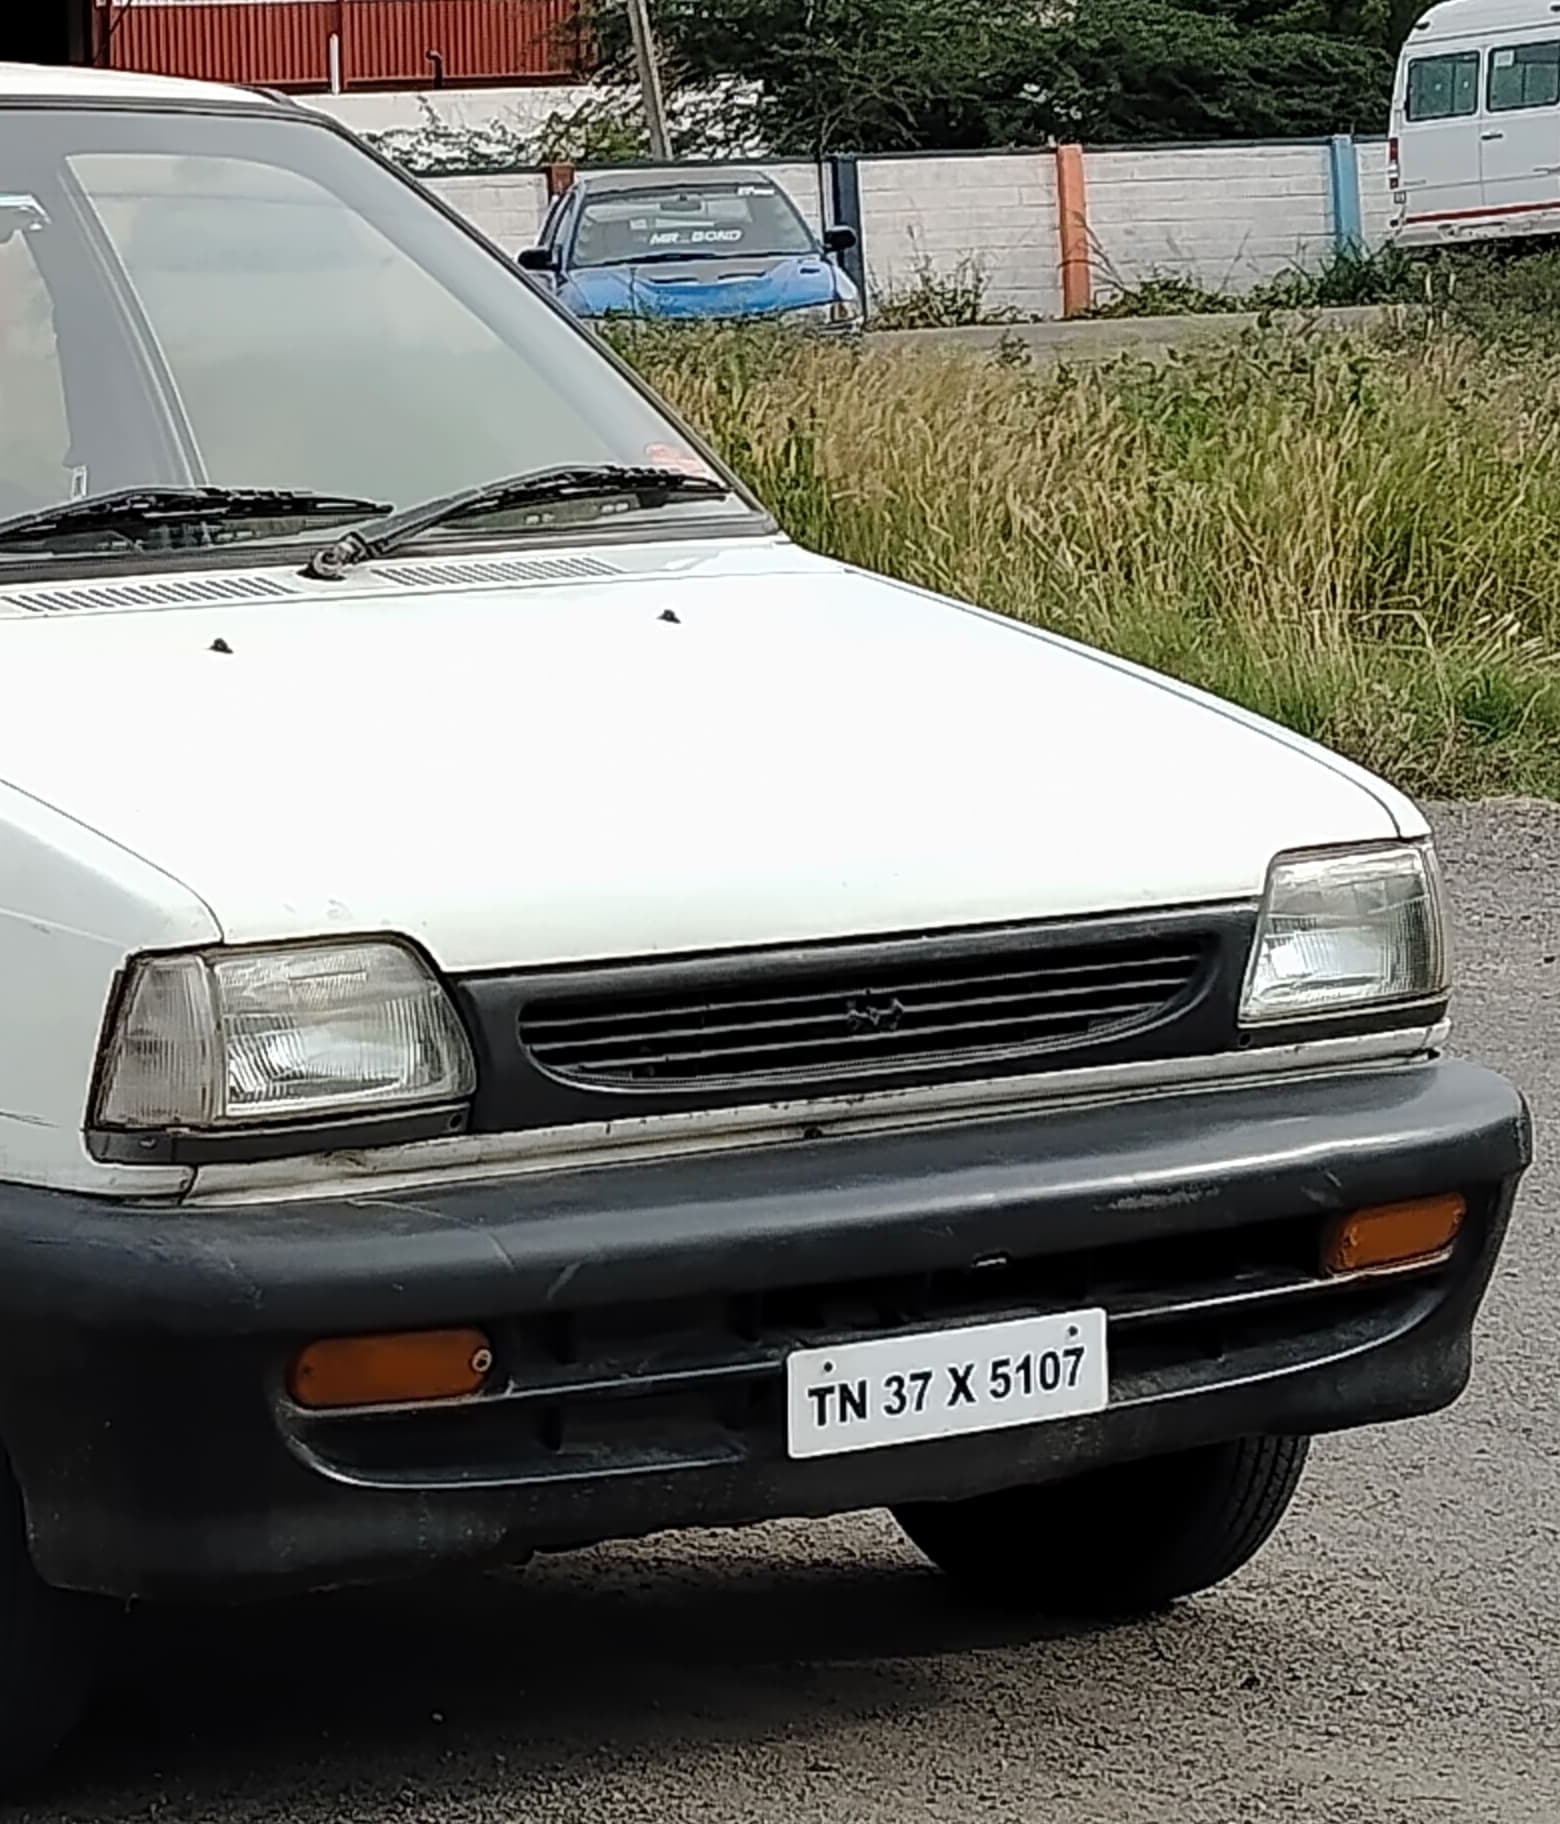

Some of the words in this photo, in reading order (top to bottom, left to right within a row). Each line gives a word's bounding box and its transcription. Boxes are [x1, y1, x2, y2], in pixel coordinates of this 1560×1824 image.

[690, 229, 743, 243] BOND
[807, 1380, 867, 1426] TN
[883, 1370, 933, 1416] 37
[947, 1363, 976, 1407] X
[989, 1346, 1085, 1399] 5107
